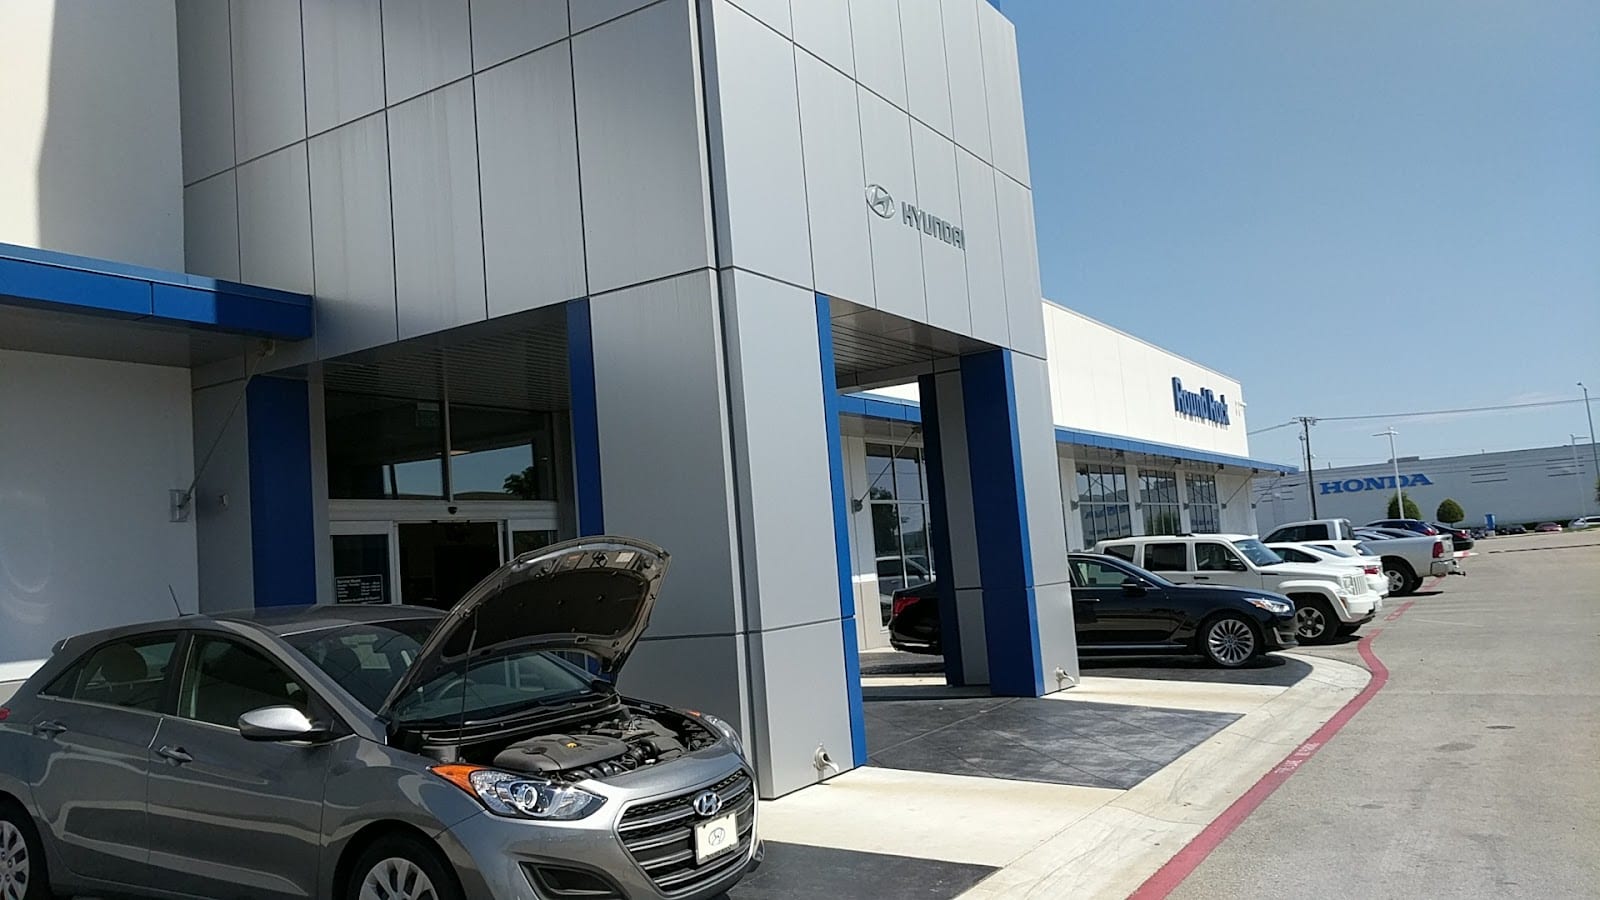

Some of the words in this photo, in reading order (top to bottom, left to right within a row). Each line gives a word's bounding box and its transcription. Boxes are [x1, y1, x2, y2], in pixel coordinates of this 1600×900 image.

[901, 201, 966, 251] HYUNDAI
[1171, 376, 1209, 420] Round
[1204, 388, 1230, 426] Rock
[1319, 473, 1434, 495] HONDA
